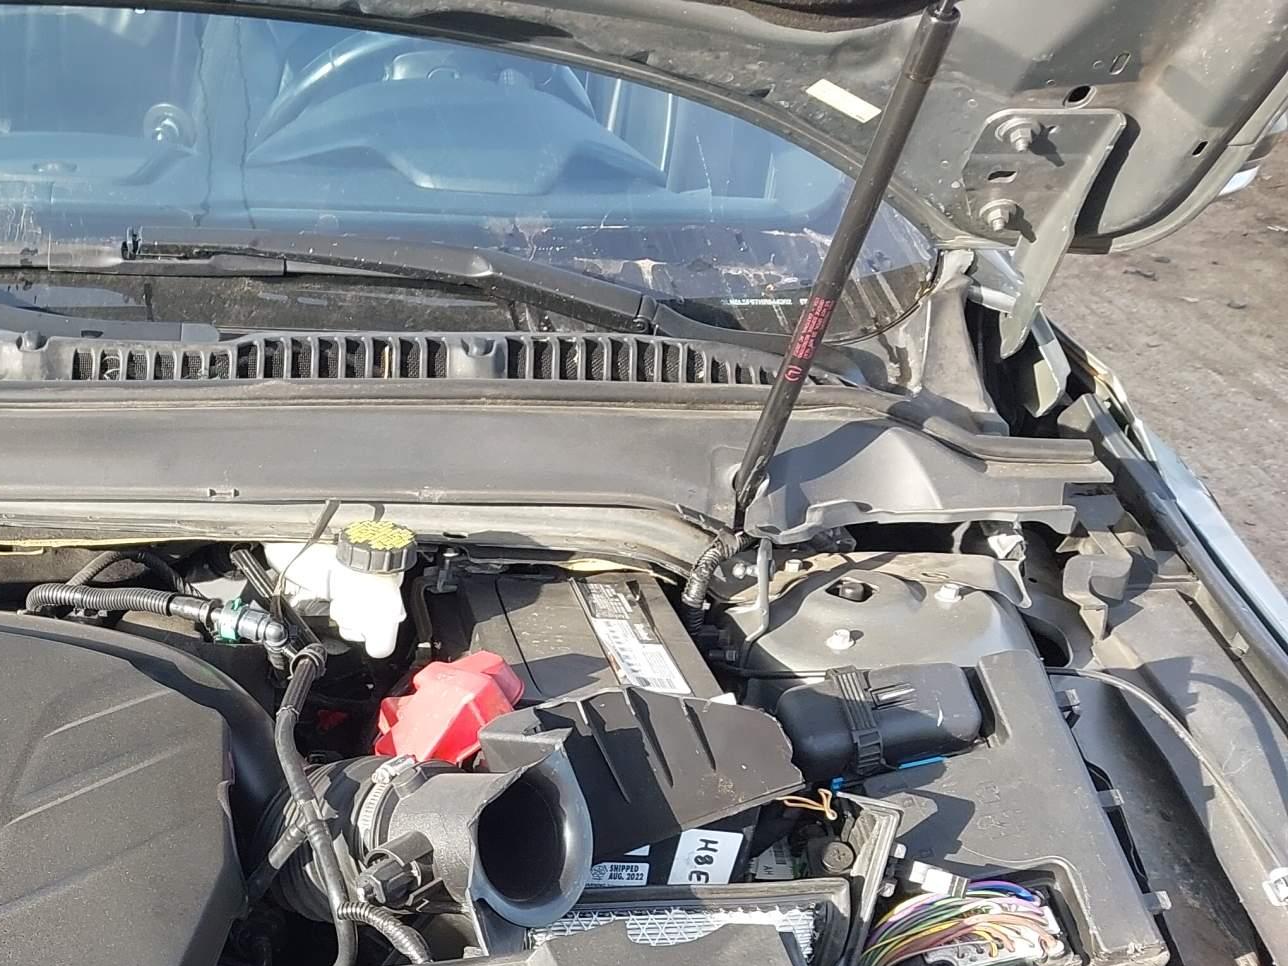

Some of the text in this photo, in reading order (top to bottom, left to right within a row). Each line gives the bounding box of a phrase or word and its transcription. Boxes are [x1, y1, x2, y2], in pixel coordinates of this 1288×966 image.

[689, 838, 719, 884] H8E
[608, 864, 640, 873] SHIPPED
[607, 872, 645, 881] AUG. 2022
